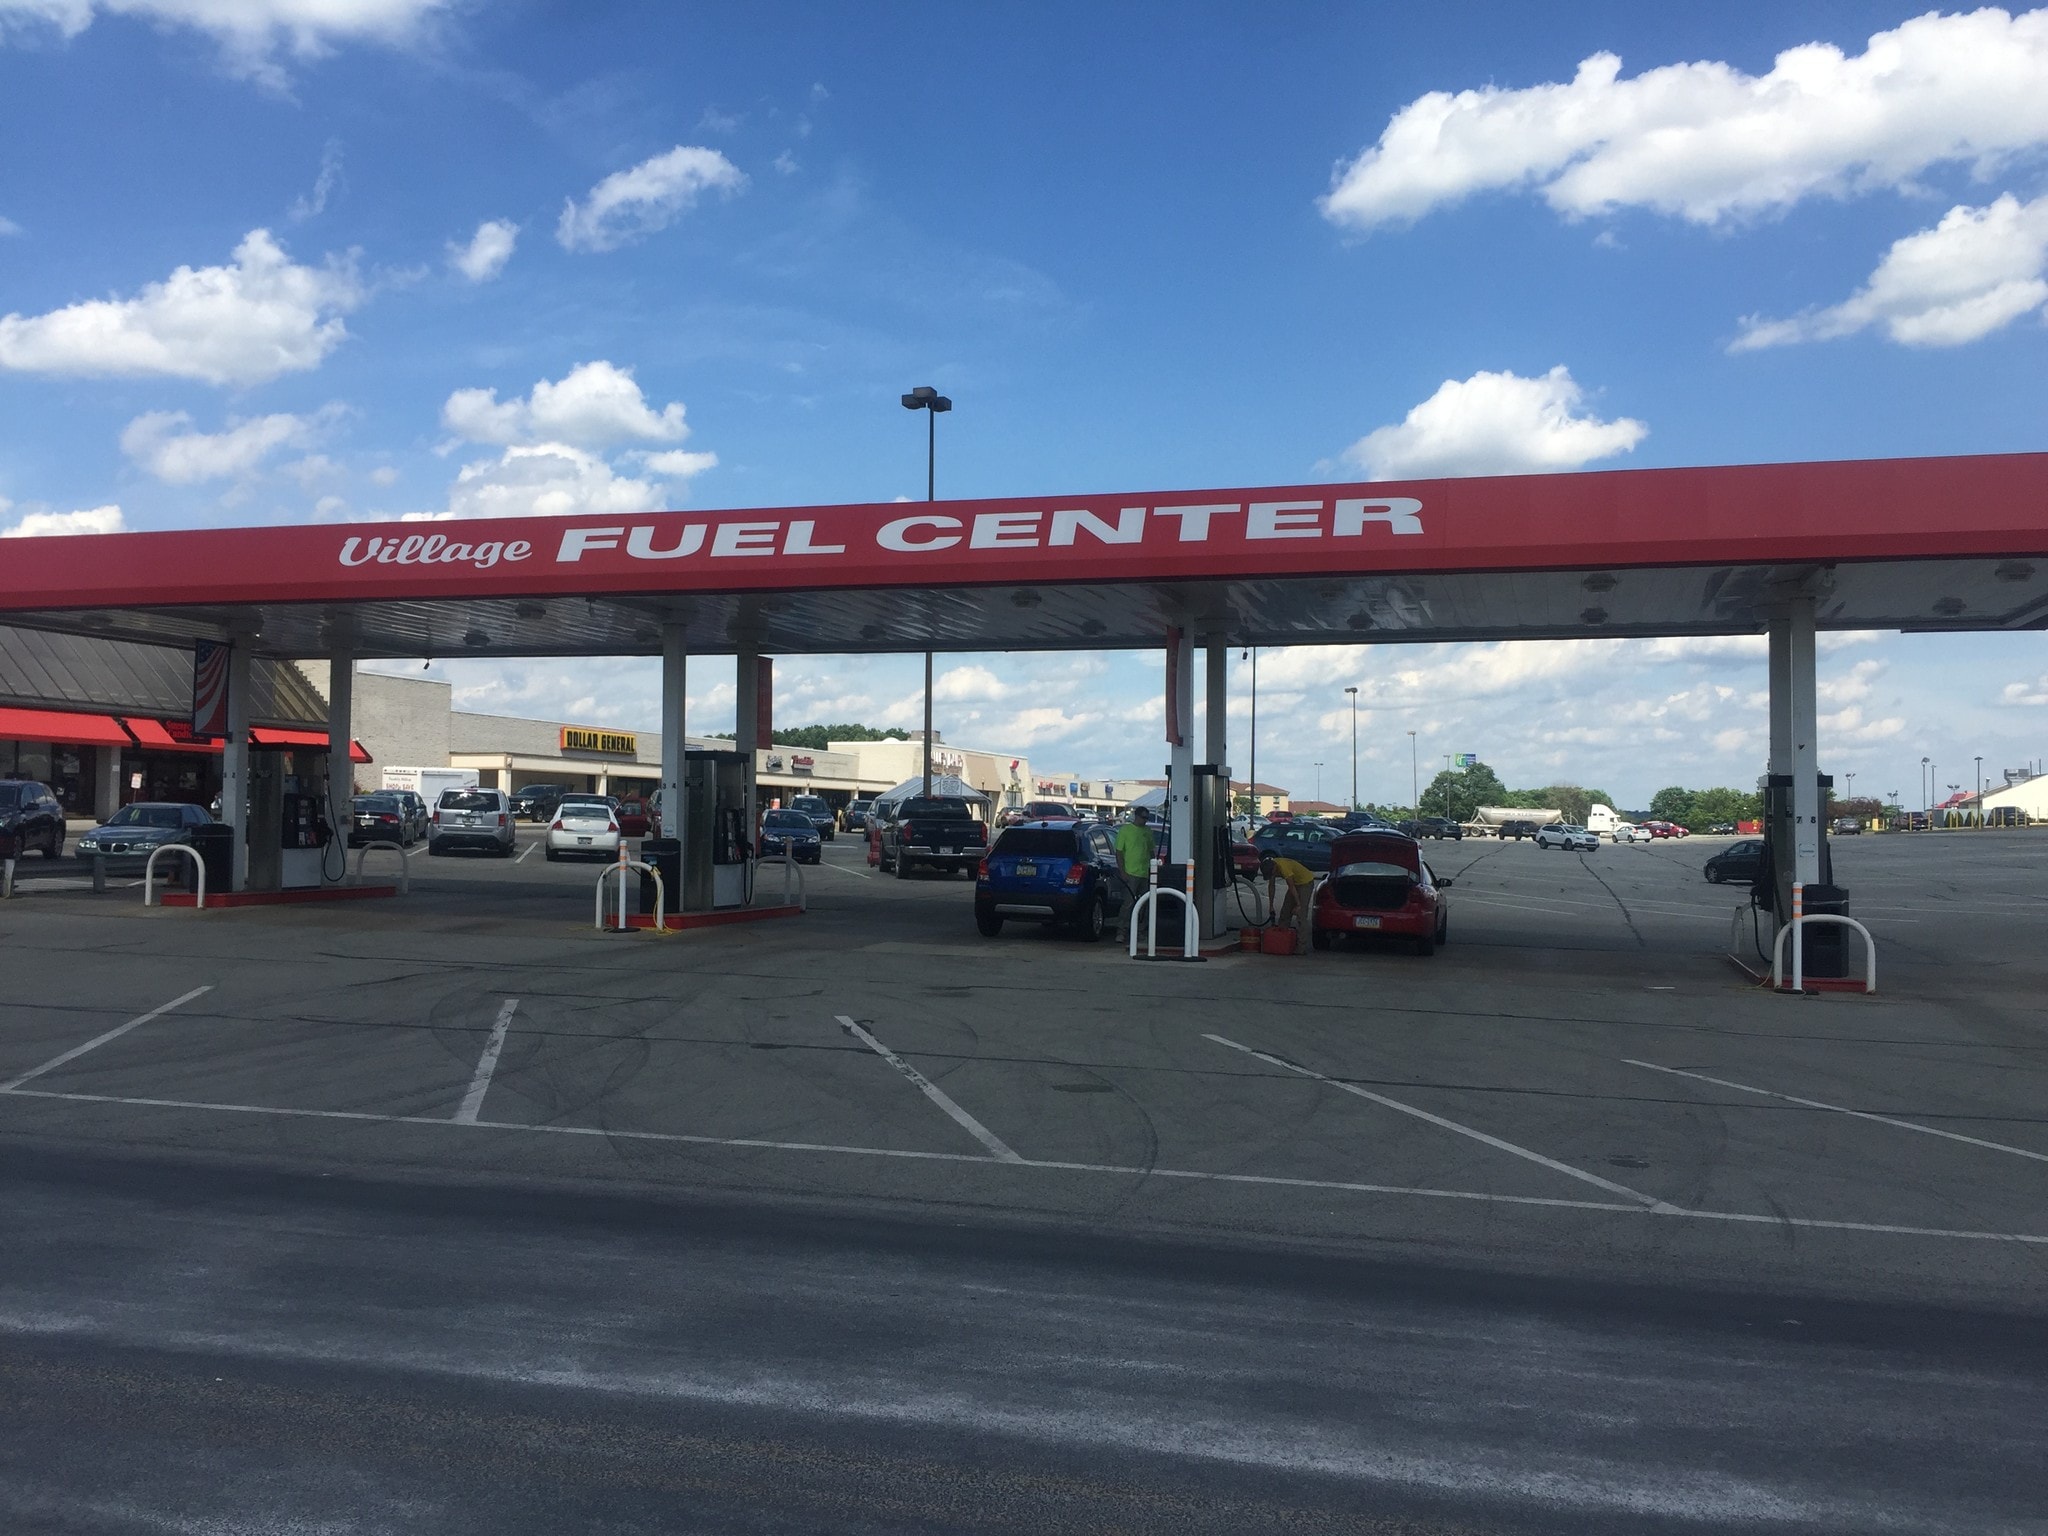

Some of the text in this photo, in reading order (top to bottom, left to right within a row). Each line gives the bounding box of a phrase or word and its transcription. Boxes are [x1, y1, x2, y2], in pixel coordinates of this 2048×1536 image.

[339, 497, 1424, 569] Village FUEL CENTER
[566, 730, 635, 752] DOLLAR GENERAL
[1796, 816, 1817, 824] 7 8
